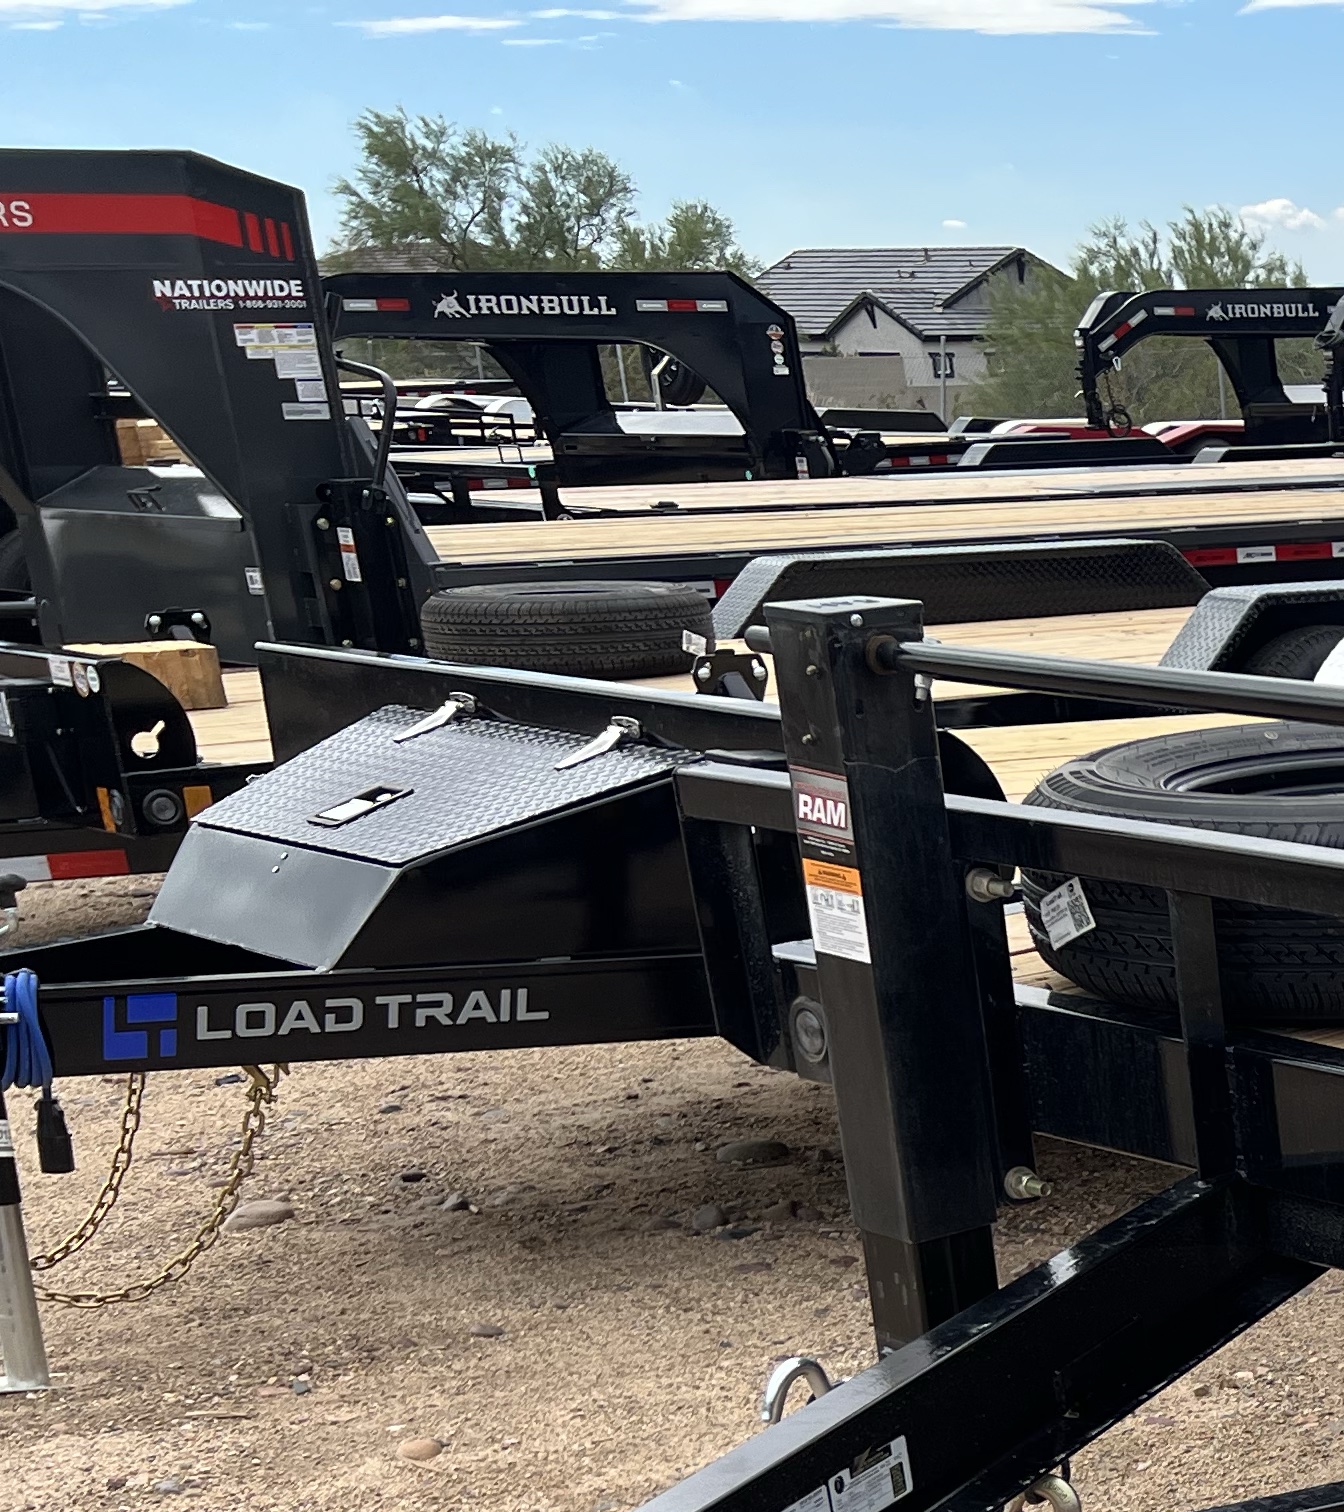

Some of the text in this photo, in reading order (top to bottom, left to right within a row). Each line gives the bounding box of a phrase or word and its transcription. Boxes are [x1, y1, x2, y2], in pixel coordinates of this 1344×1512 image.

[152, 279, 304, 298] NATIONWIDE
[172, 298, 234, 310] TRAILERS
[466, 295, 617, 315] IRONBULL
[1227, 303, 1319, 318] IRONBULL
[798, 793, 846, 828] RAM
[196, 987, 550, 1041] LOAD TRAIL
